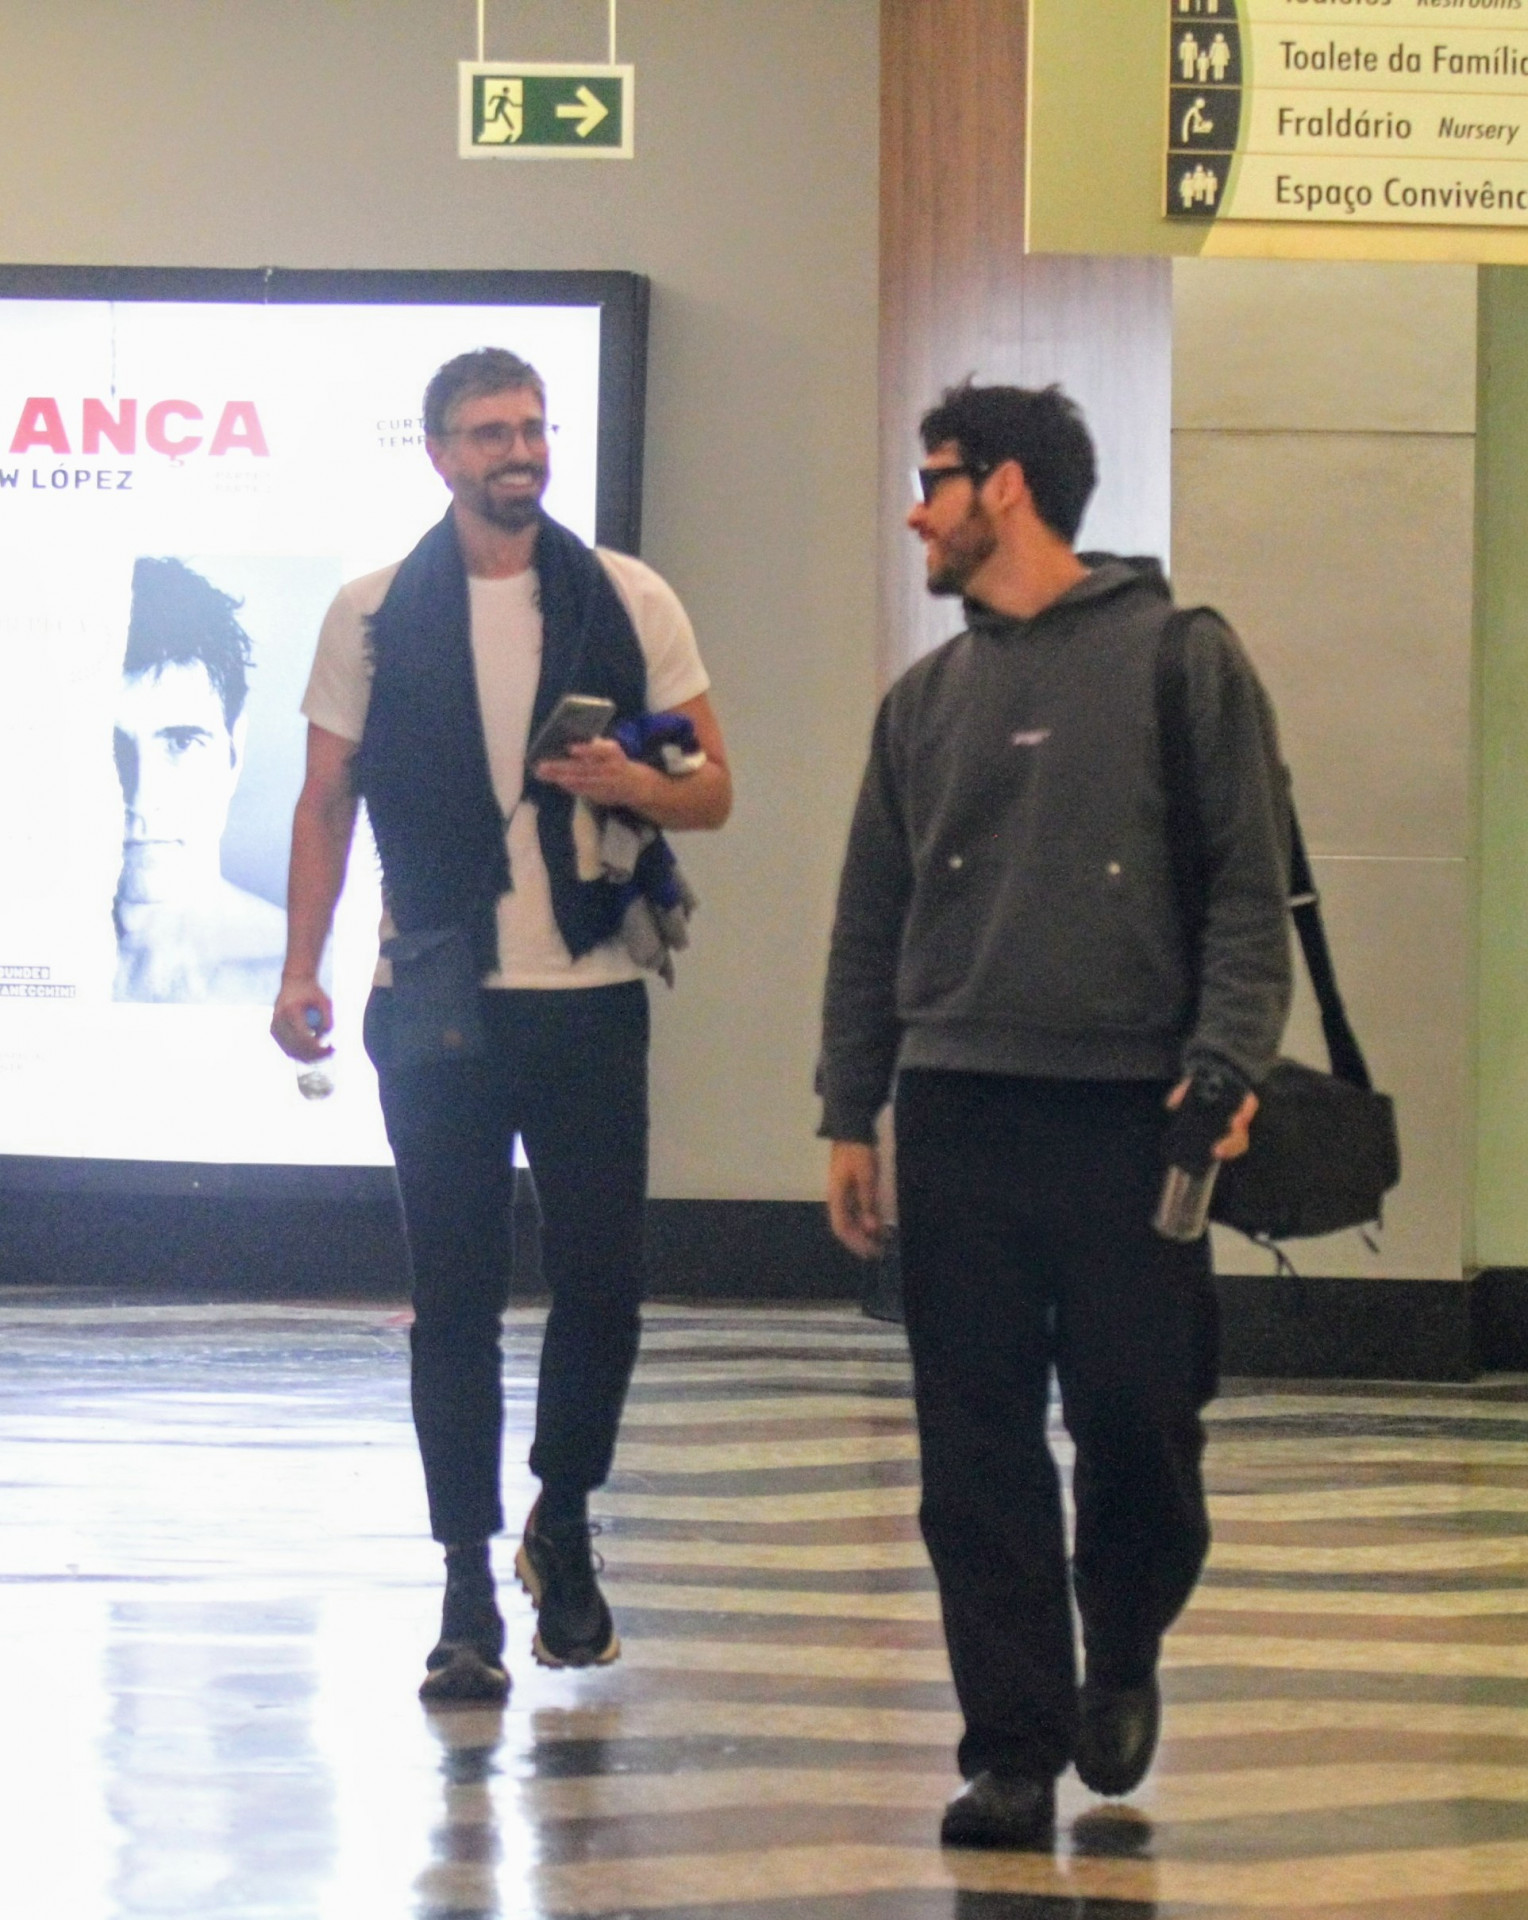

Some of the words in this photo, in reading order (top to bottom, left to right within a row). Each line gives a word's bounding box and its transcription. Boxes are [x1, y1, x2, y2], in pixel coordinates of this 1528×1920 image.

[1279, 41, 1377, 71] Toalete
[1389, 42, 1421, 73] da
[1278, 107, 1411, 139] Fraldário
[1438, 117, 1520, 145] Nursery
[1276, 175, 1371, 214] Espaço
[8, 397, 270, 468] ANÇA
[32, 463, 133, 489] LÓPEZ
